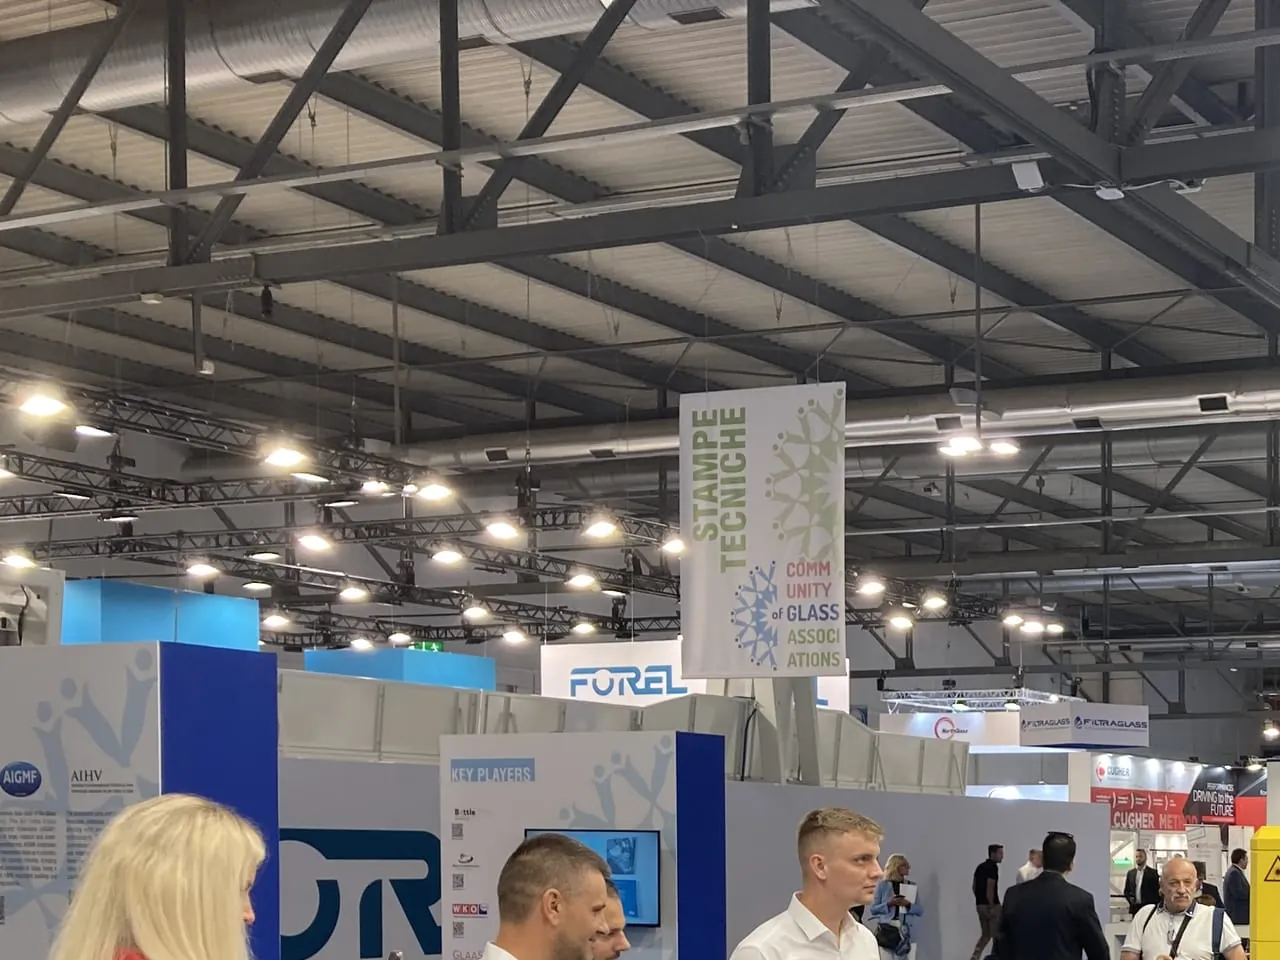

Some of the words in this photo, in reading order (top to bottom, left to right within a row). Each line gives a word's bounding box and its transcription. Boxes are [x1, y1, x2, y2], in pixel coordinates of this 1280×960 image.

[692, 409, 718, 541] STAMPE
[720, 406, 746, 573] TECNICHE
[787, 561, 830, 577] COMM
[787, 582, 832, 599] UNITY
[772, 609, 784, 620] of
[787, 603, 839, 621] GLASS
[787, 628, 840, 644] ASSOCI
[787, 652, 840, 668] ATIONS
[570, 665, 688, 697] FOREL
[1026, 717, 1070, 728] FILTRAGLASS
[1083, 717, 1147, 729] FILTRAGLASS
[3, 770, 38, 785] AIGMF
[71, 769, 103, 782] AIHV
[452, 767, 474, 781] KEY
[477, 767, 531, 782] PLAYERS
[1193, 790, 1217, 803] DRIVING
[1218, 792, 1225, 803] to
[1225, 792, 1234, 804] the
[1211, 804, 1234, 817] FUTURE
[1113, 811, 1154, 829] CUGHER
